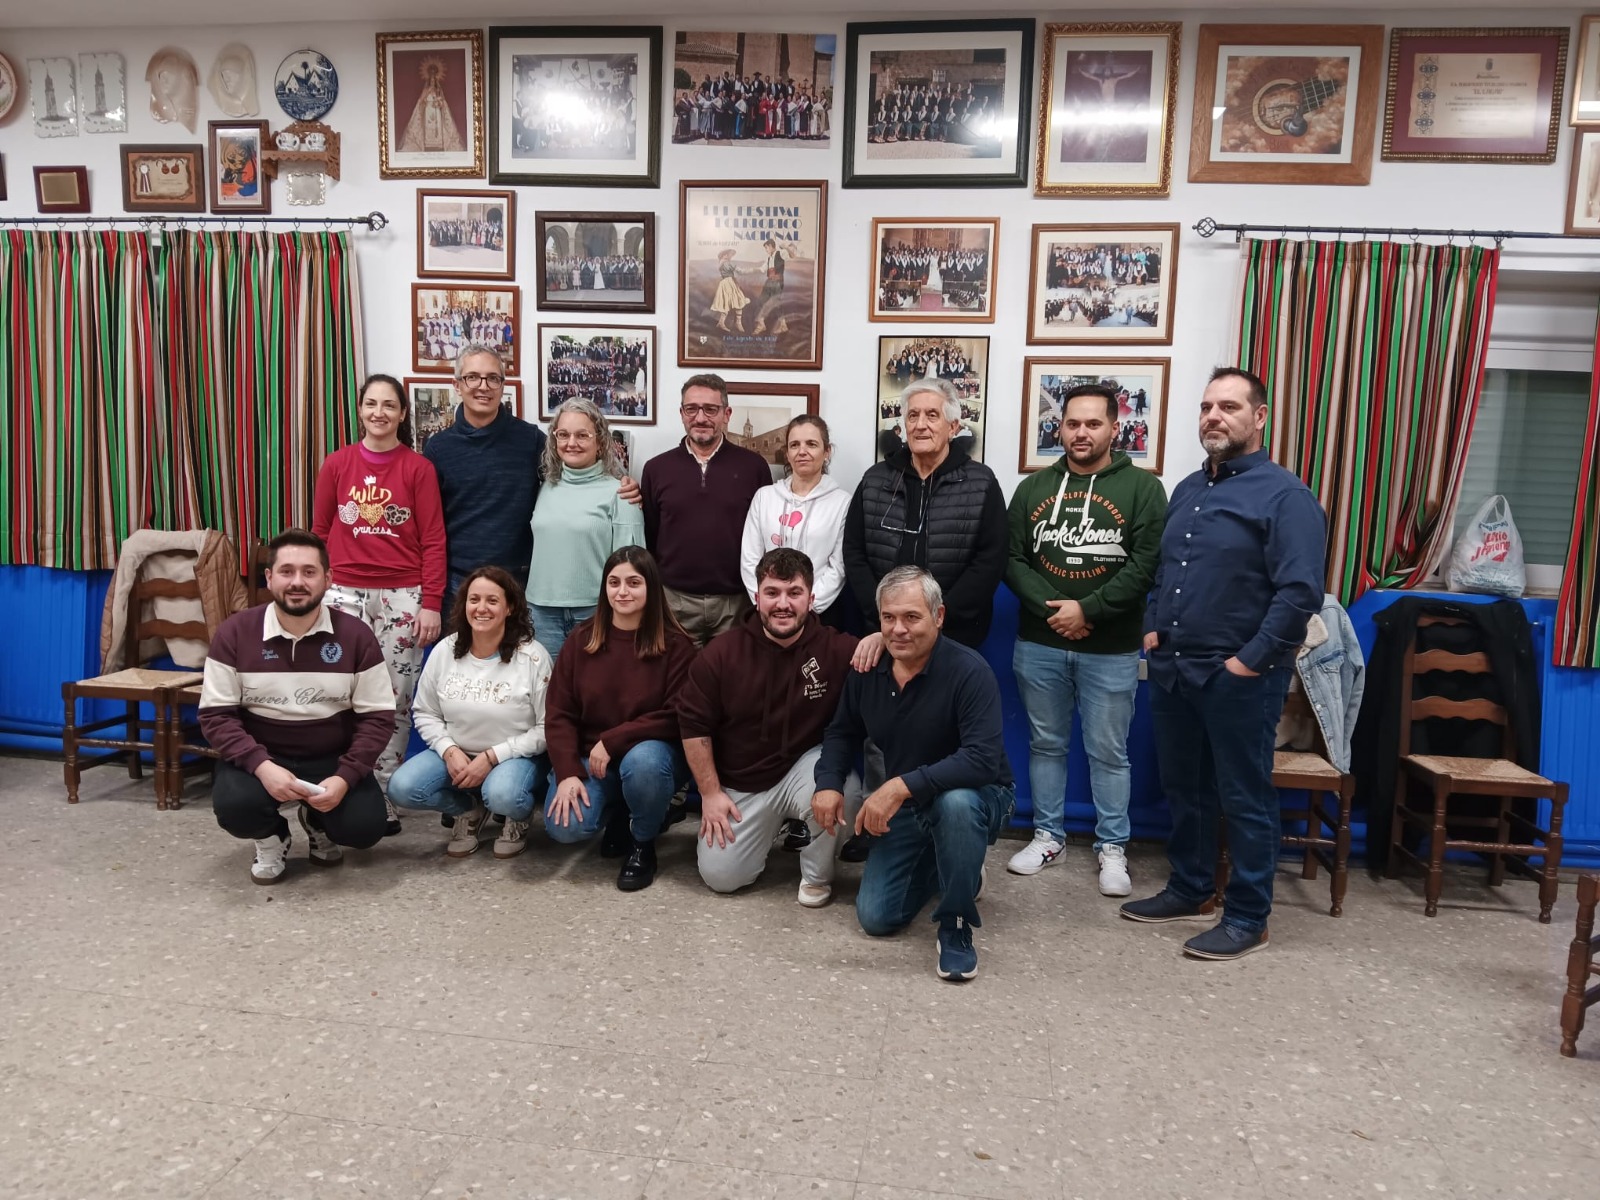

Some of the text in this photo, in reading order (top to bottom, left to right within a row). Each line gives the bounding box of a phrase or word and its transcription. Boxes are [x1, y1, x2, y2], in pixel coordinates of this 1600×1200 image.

[737, 205, 801, 217] FESTIVAL
[733, 230, 801, 242] NACIONAL
[348, 484, 392, 506] WILD
[1030, 495, 1058, 522] CRAFTE
[1102, 499, 1126, 525] GOODS
[1039, 554, 1107, 580] CLASSIC STYLING
[445, 676, 511, 704] CHIC
